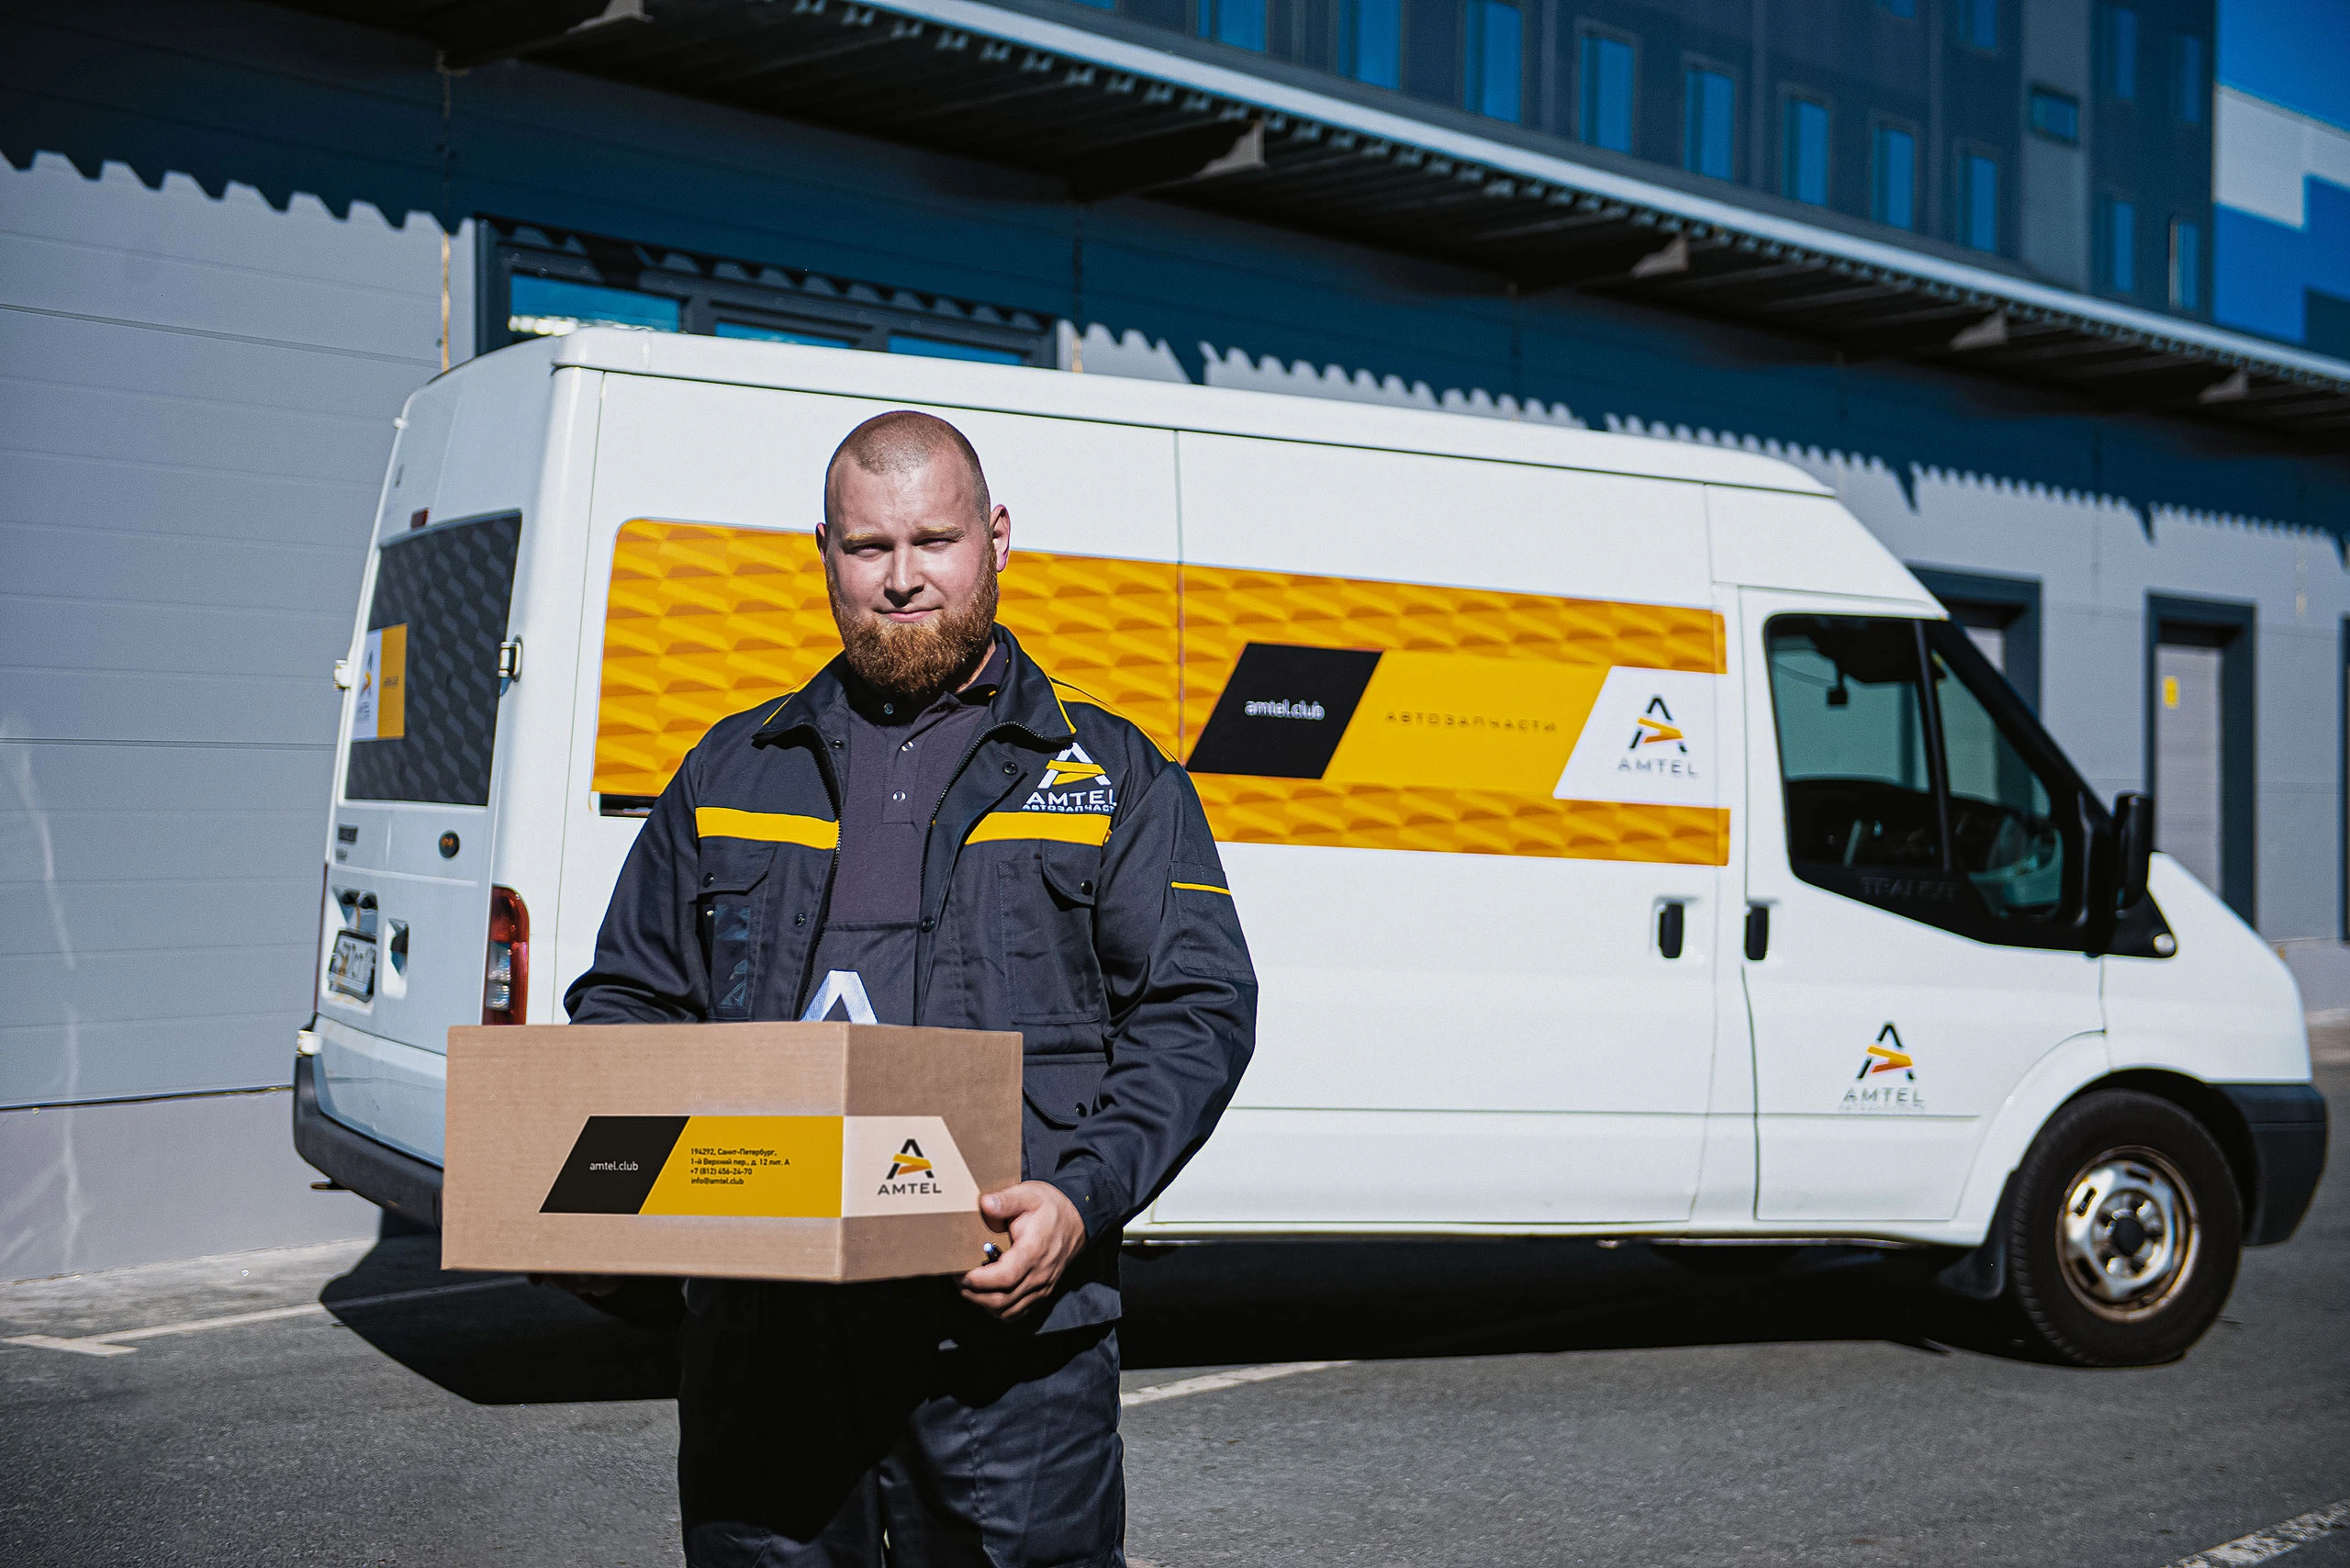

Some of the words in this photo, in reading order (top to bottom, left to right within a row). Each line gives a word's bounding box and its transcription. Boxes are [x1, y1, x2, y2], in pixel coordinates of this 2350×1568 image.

[1245, 699, 1326, 721] amtel.club
[1617, 756, 1698, 778] AMTEL
[1842, 1086, 1925, 1103] AMTEL
[690, 1148, 717, 1157] 194292,
[589, 1160, 639, 1171] amtel.club
[760, 1158, 768, 1166] 12
[699, 1167, 717, 1176] (812)
[718, 1167, 753, 1176] 456-24-70
[690, 1176, 744, 1185] info@amtel.club
[877, 1182, 943, 1196] AMTEL
